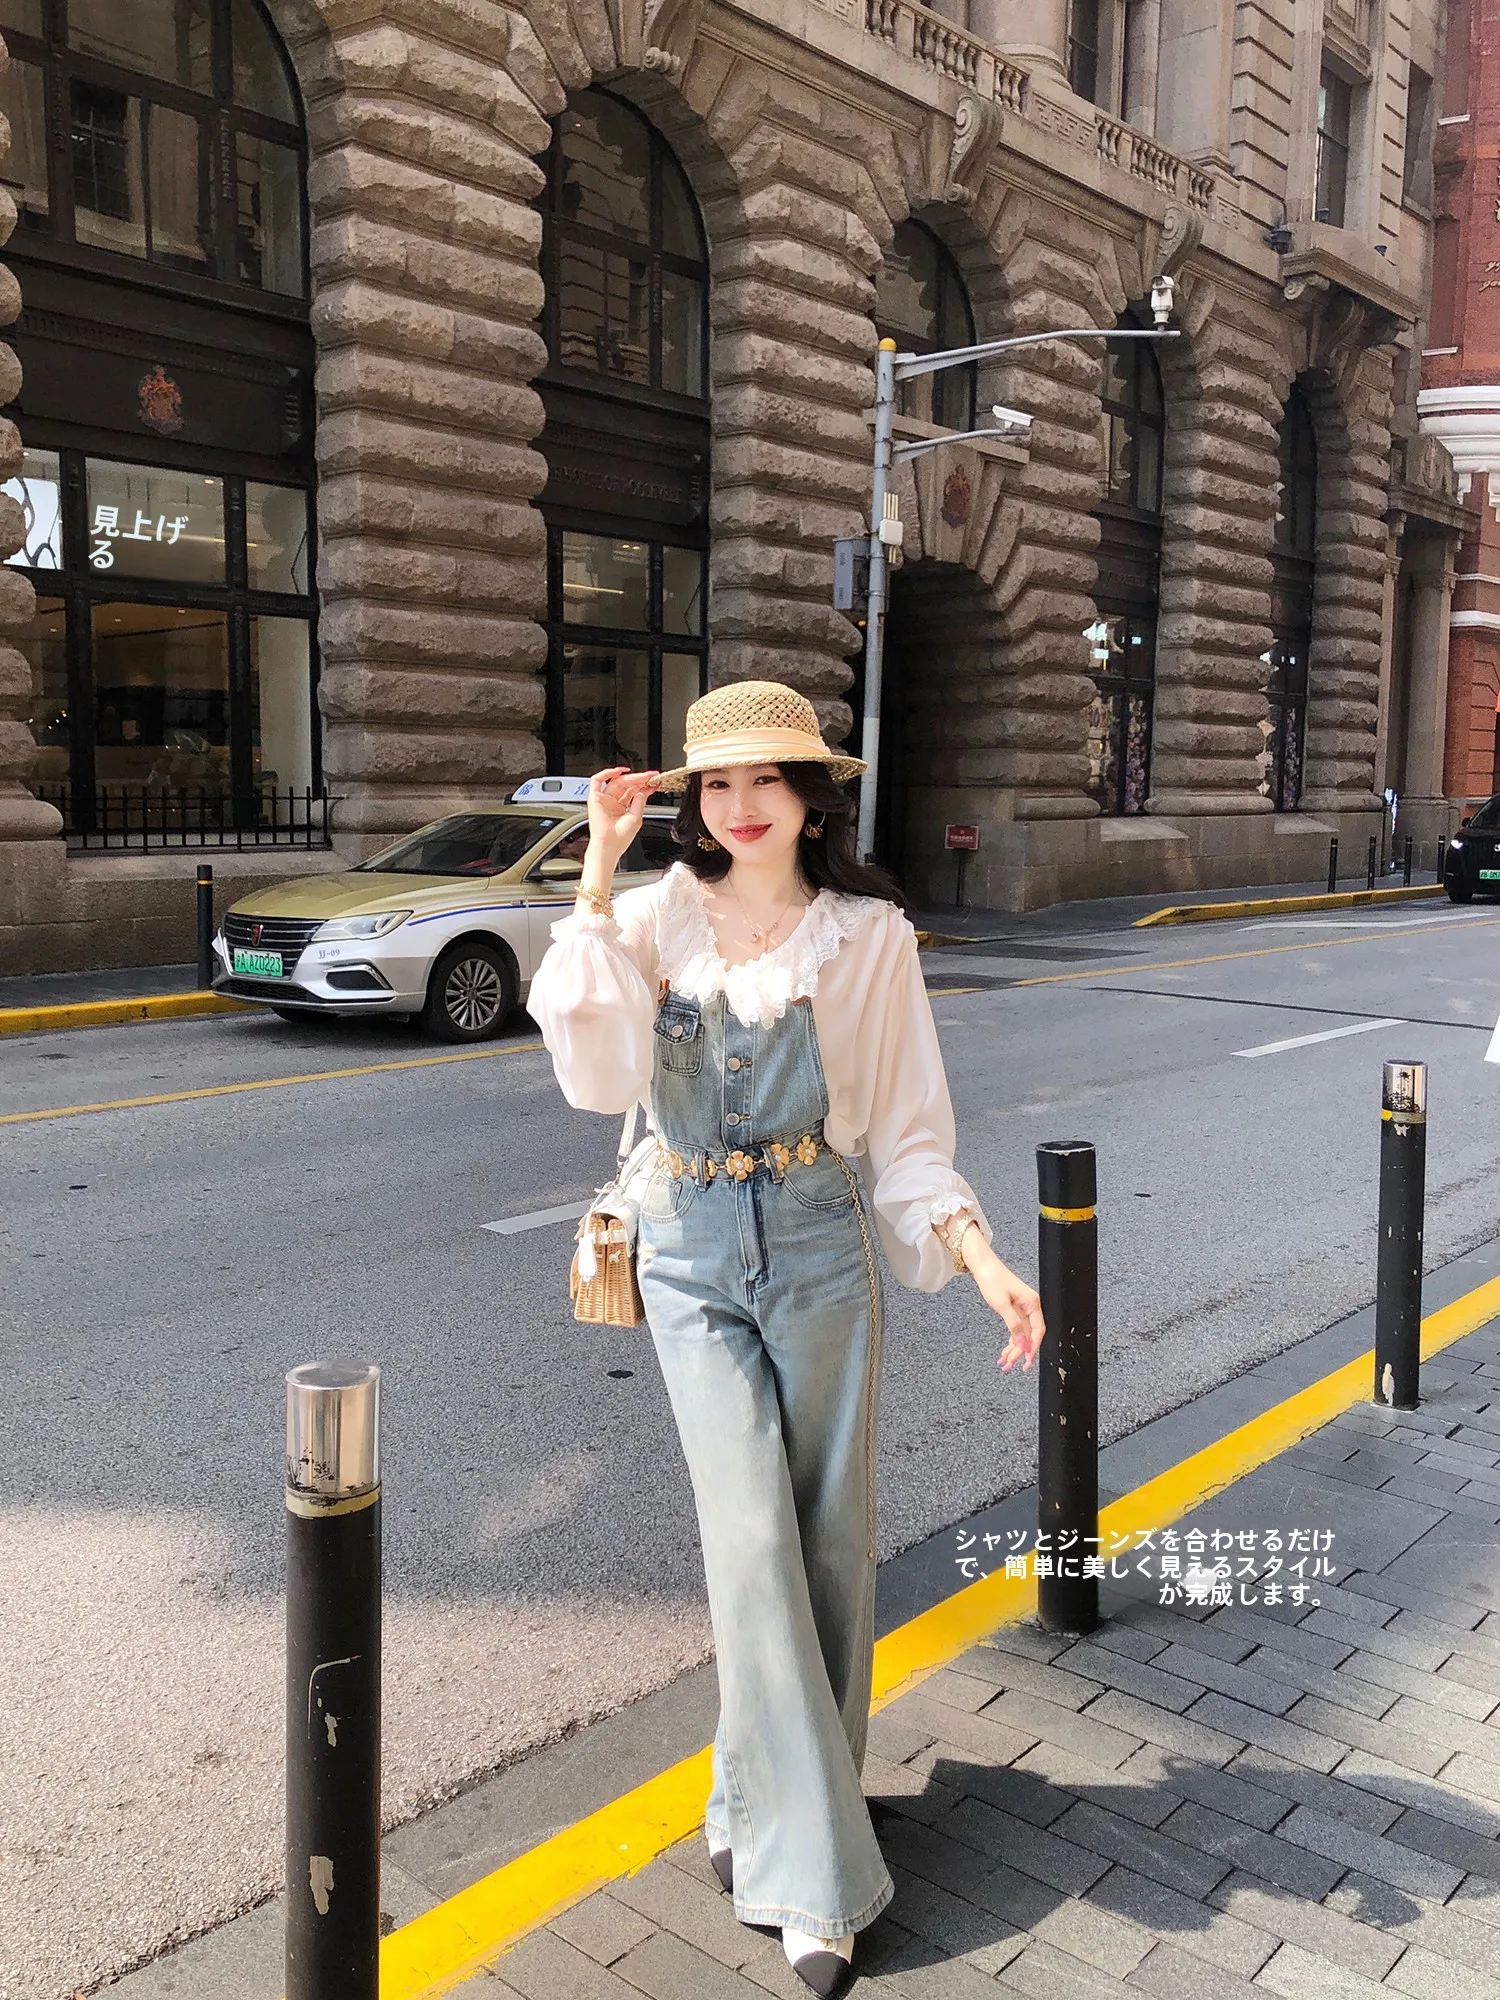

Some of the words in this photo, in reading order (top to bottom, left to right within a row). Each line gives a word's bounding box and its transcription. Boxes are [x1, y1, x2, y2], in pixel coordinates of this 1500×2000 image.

[90, 504, 190, 545] 見上げ
[88, 539, 115, 569] る
[318, 948, 341, 960] JJ-09
